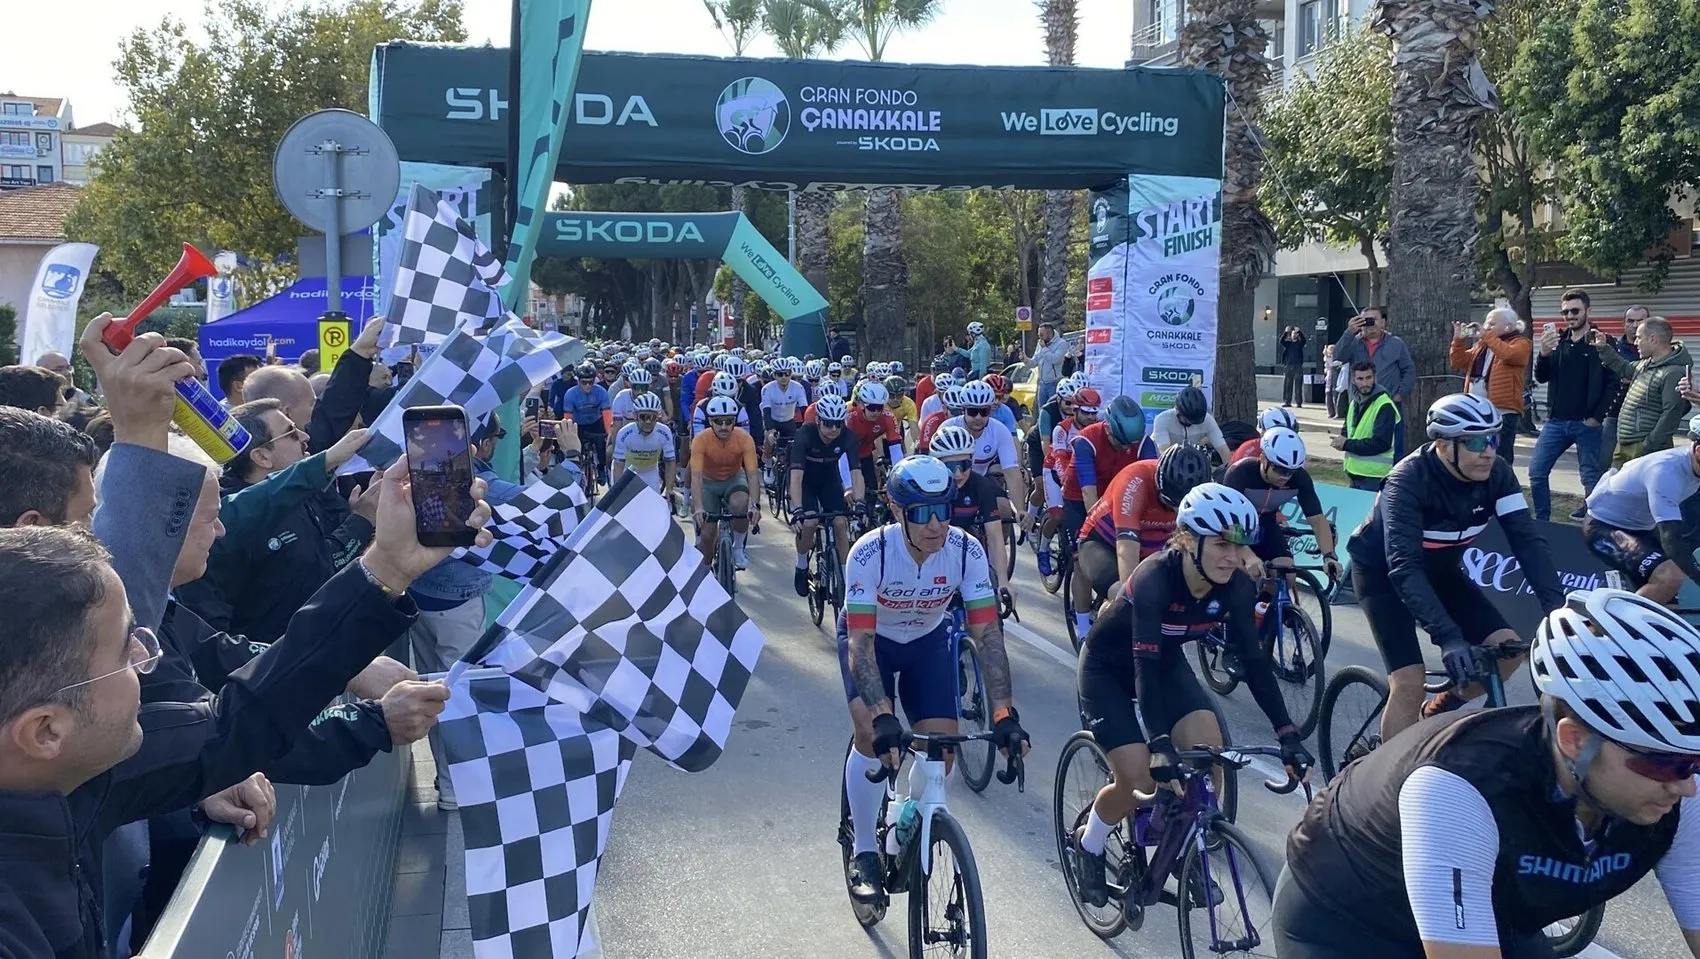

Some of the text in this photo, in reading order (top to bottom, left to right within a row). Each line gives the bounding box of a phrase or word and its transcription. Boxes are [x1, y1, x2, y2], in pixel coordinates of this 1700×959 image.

[446, 87, 658, 127] SDA
[800, 86, 918, 106] GRAN FONDO
[800, 107, 941, 132] ÇANAKKALE
[1001, 111, 1037, 131] We
[1100, 111, 1179, 136] Cycling
[1136, 195, 1217, 241] START
[1163, 227, 1213, 258] FINISH
[740, 241, 754, 258] We
[772, 274, 801, 306] Cycling
[1149, 273, 1205, 296] GRAN FONDO
[1518, 852, 1631, 885] SHIMANO
